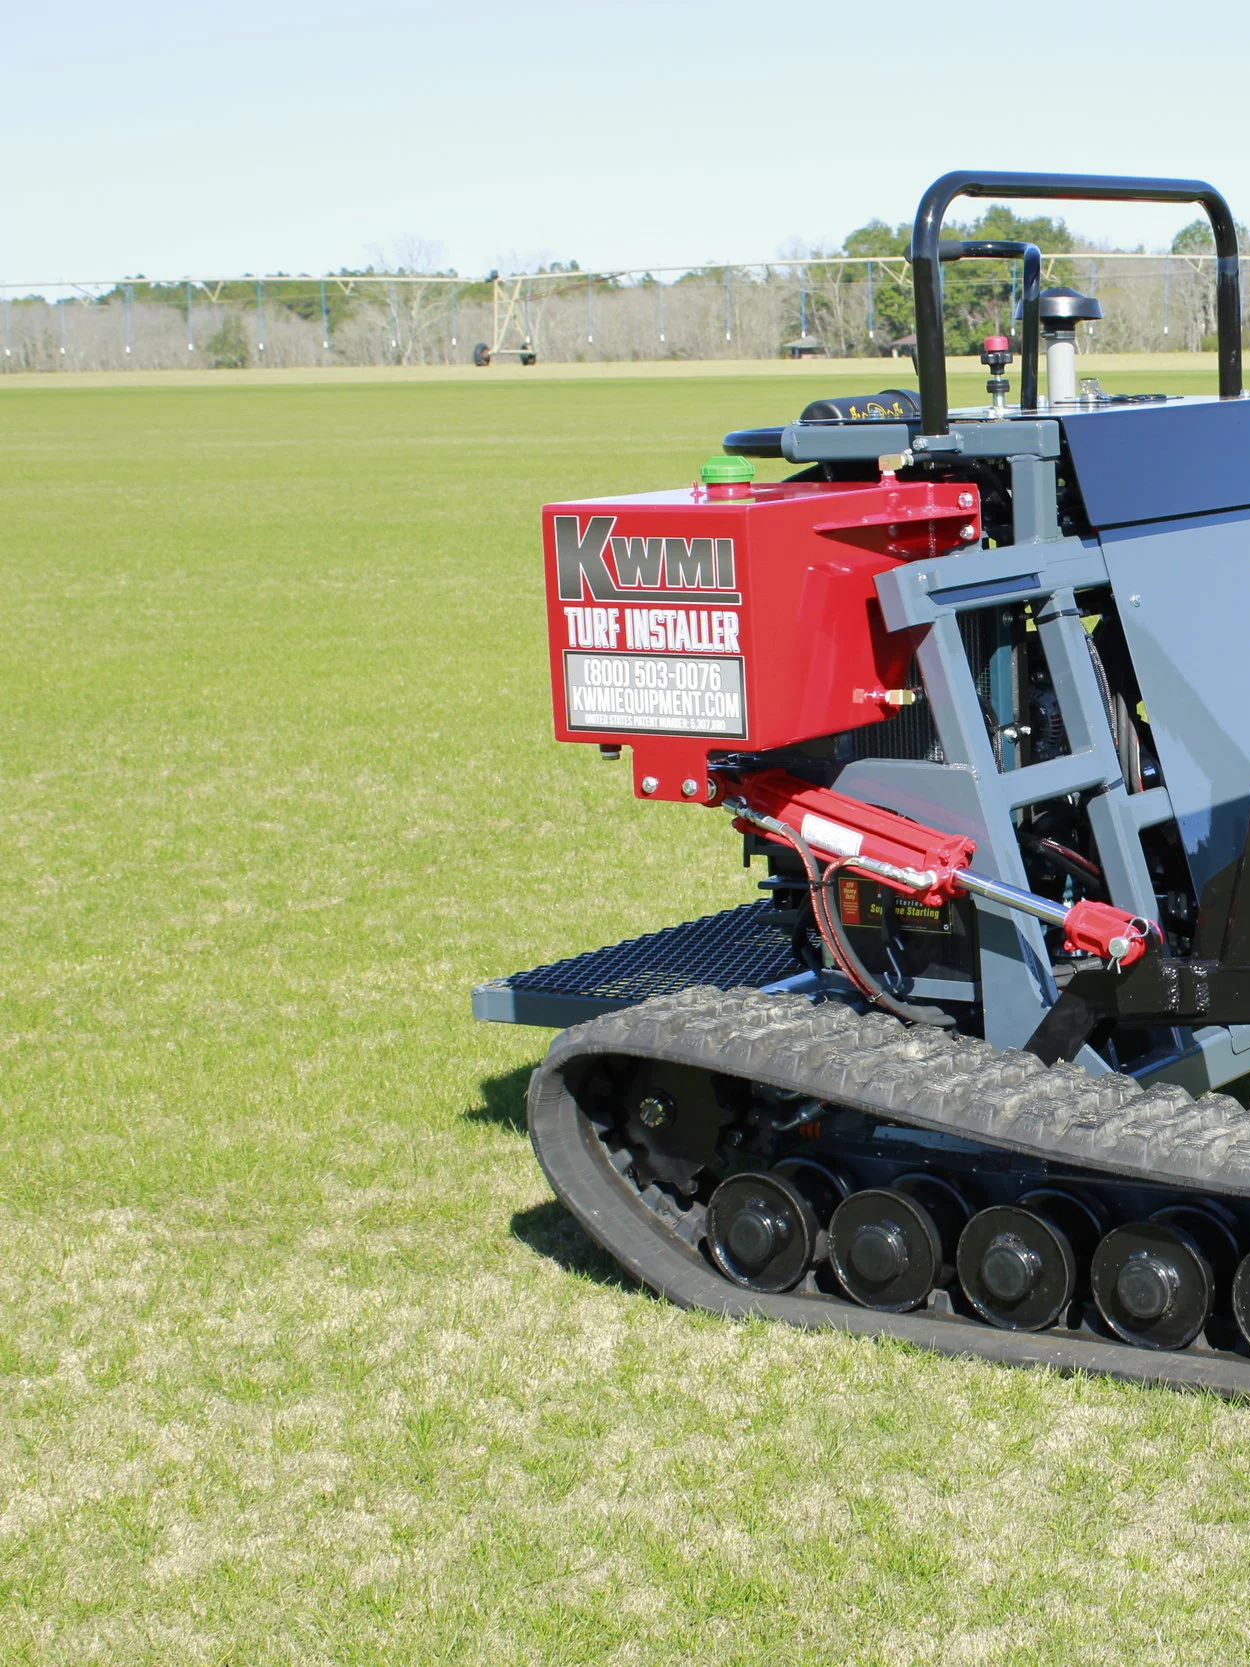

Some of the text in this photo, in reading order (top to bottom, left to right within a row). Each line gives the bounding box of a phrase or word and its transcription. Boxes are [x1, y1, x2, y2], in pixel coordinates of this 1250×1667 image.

[554, 515, 742, 605] KWMI
[563, 606, 740, 653] TURF INSTALLER
[583, 658, 721, 691] (800) 503-0076
[572, 686, 740, 718] KWMIEQUIPMENT.COM
[585, 714, 608, 725] UNITED
[609, 714, 633, 726] STATES
[634, 715, 658, 728] PATENT
[906, 906, 940, 920] Starting
